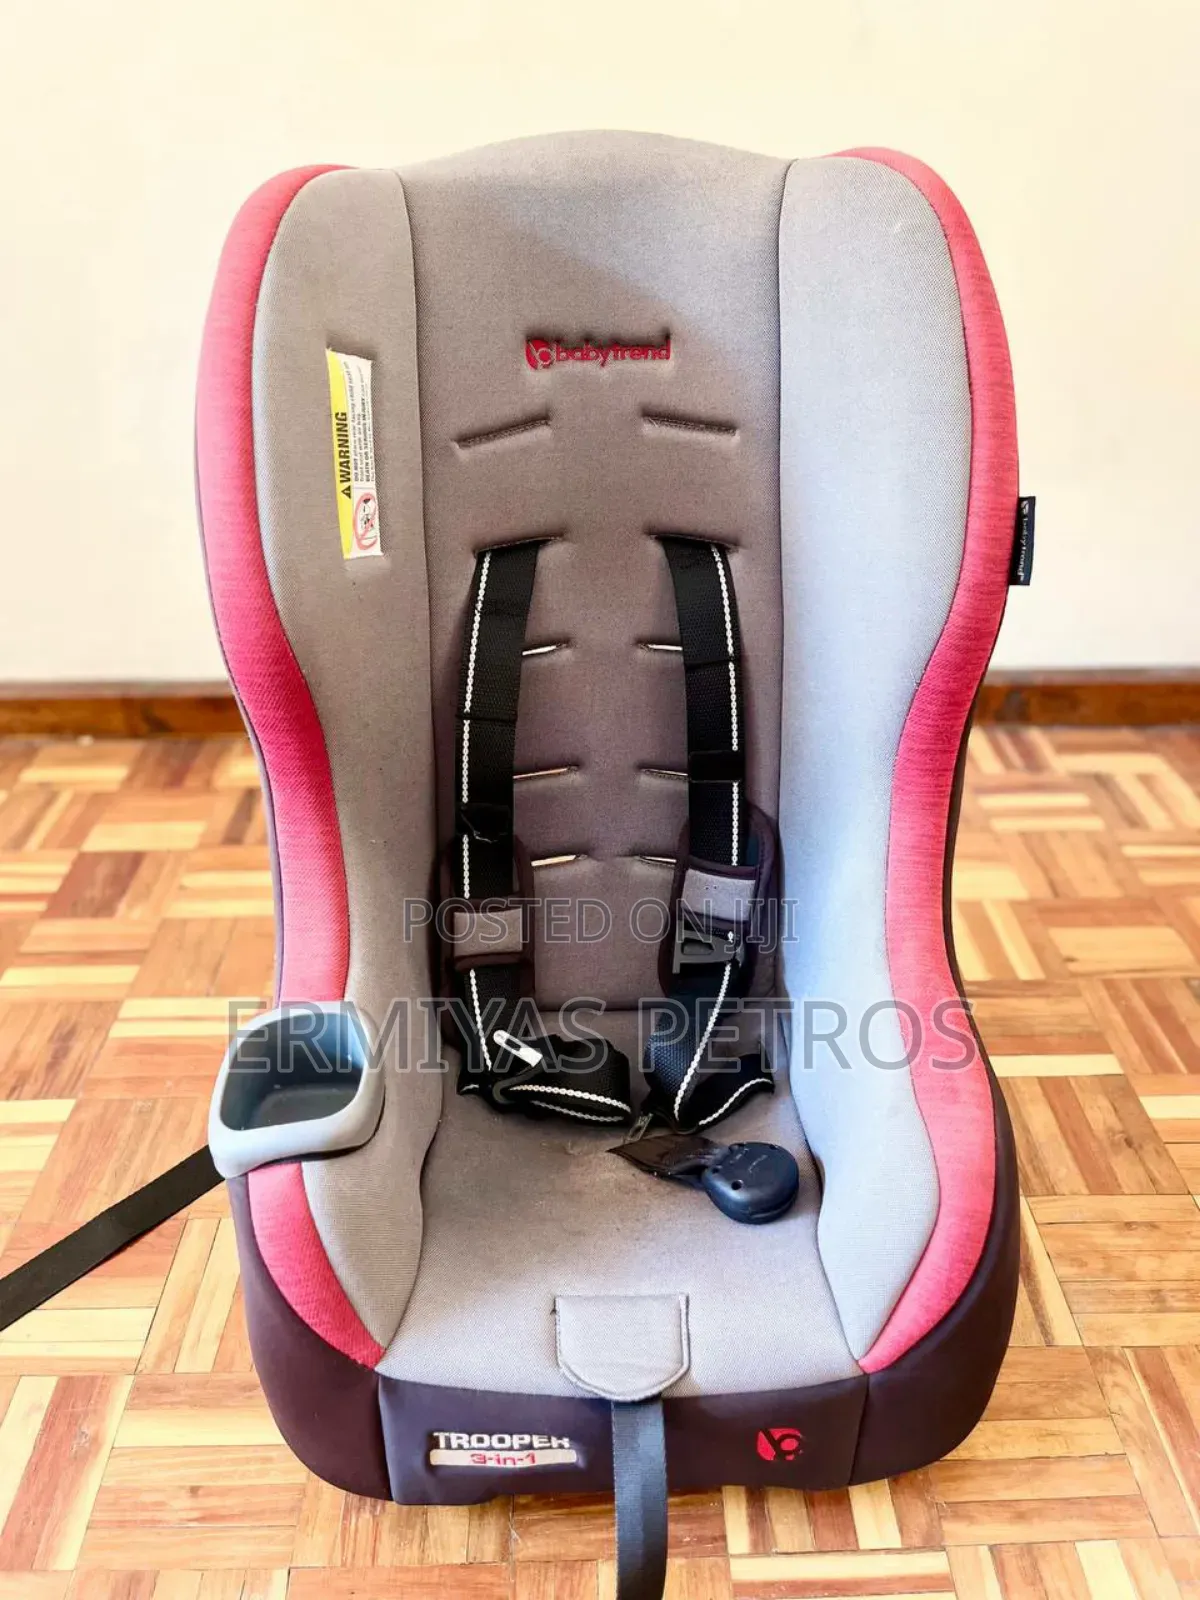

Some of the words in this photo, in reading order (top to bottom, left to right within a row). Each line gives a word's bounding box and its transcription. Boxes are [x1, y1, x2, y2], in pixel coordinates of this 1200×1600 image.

[555, 338, 671, 367] babytrend
[335, 412, 350, 484] WARNING
[471, 1453, 537, 1466] 3-in-1
